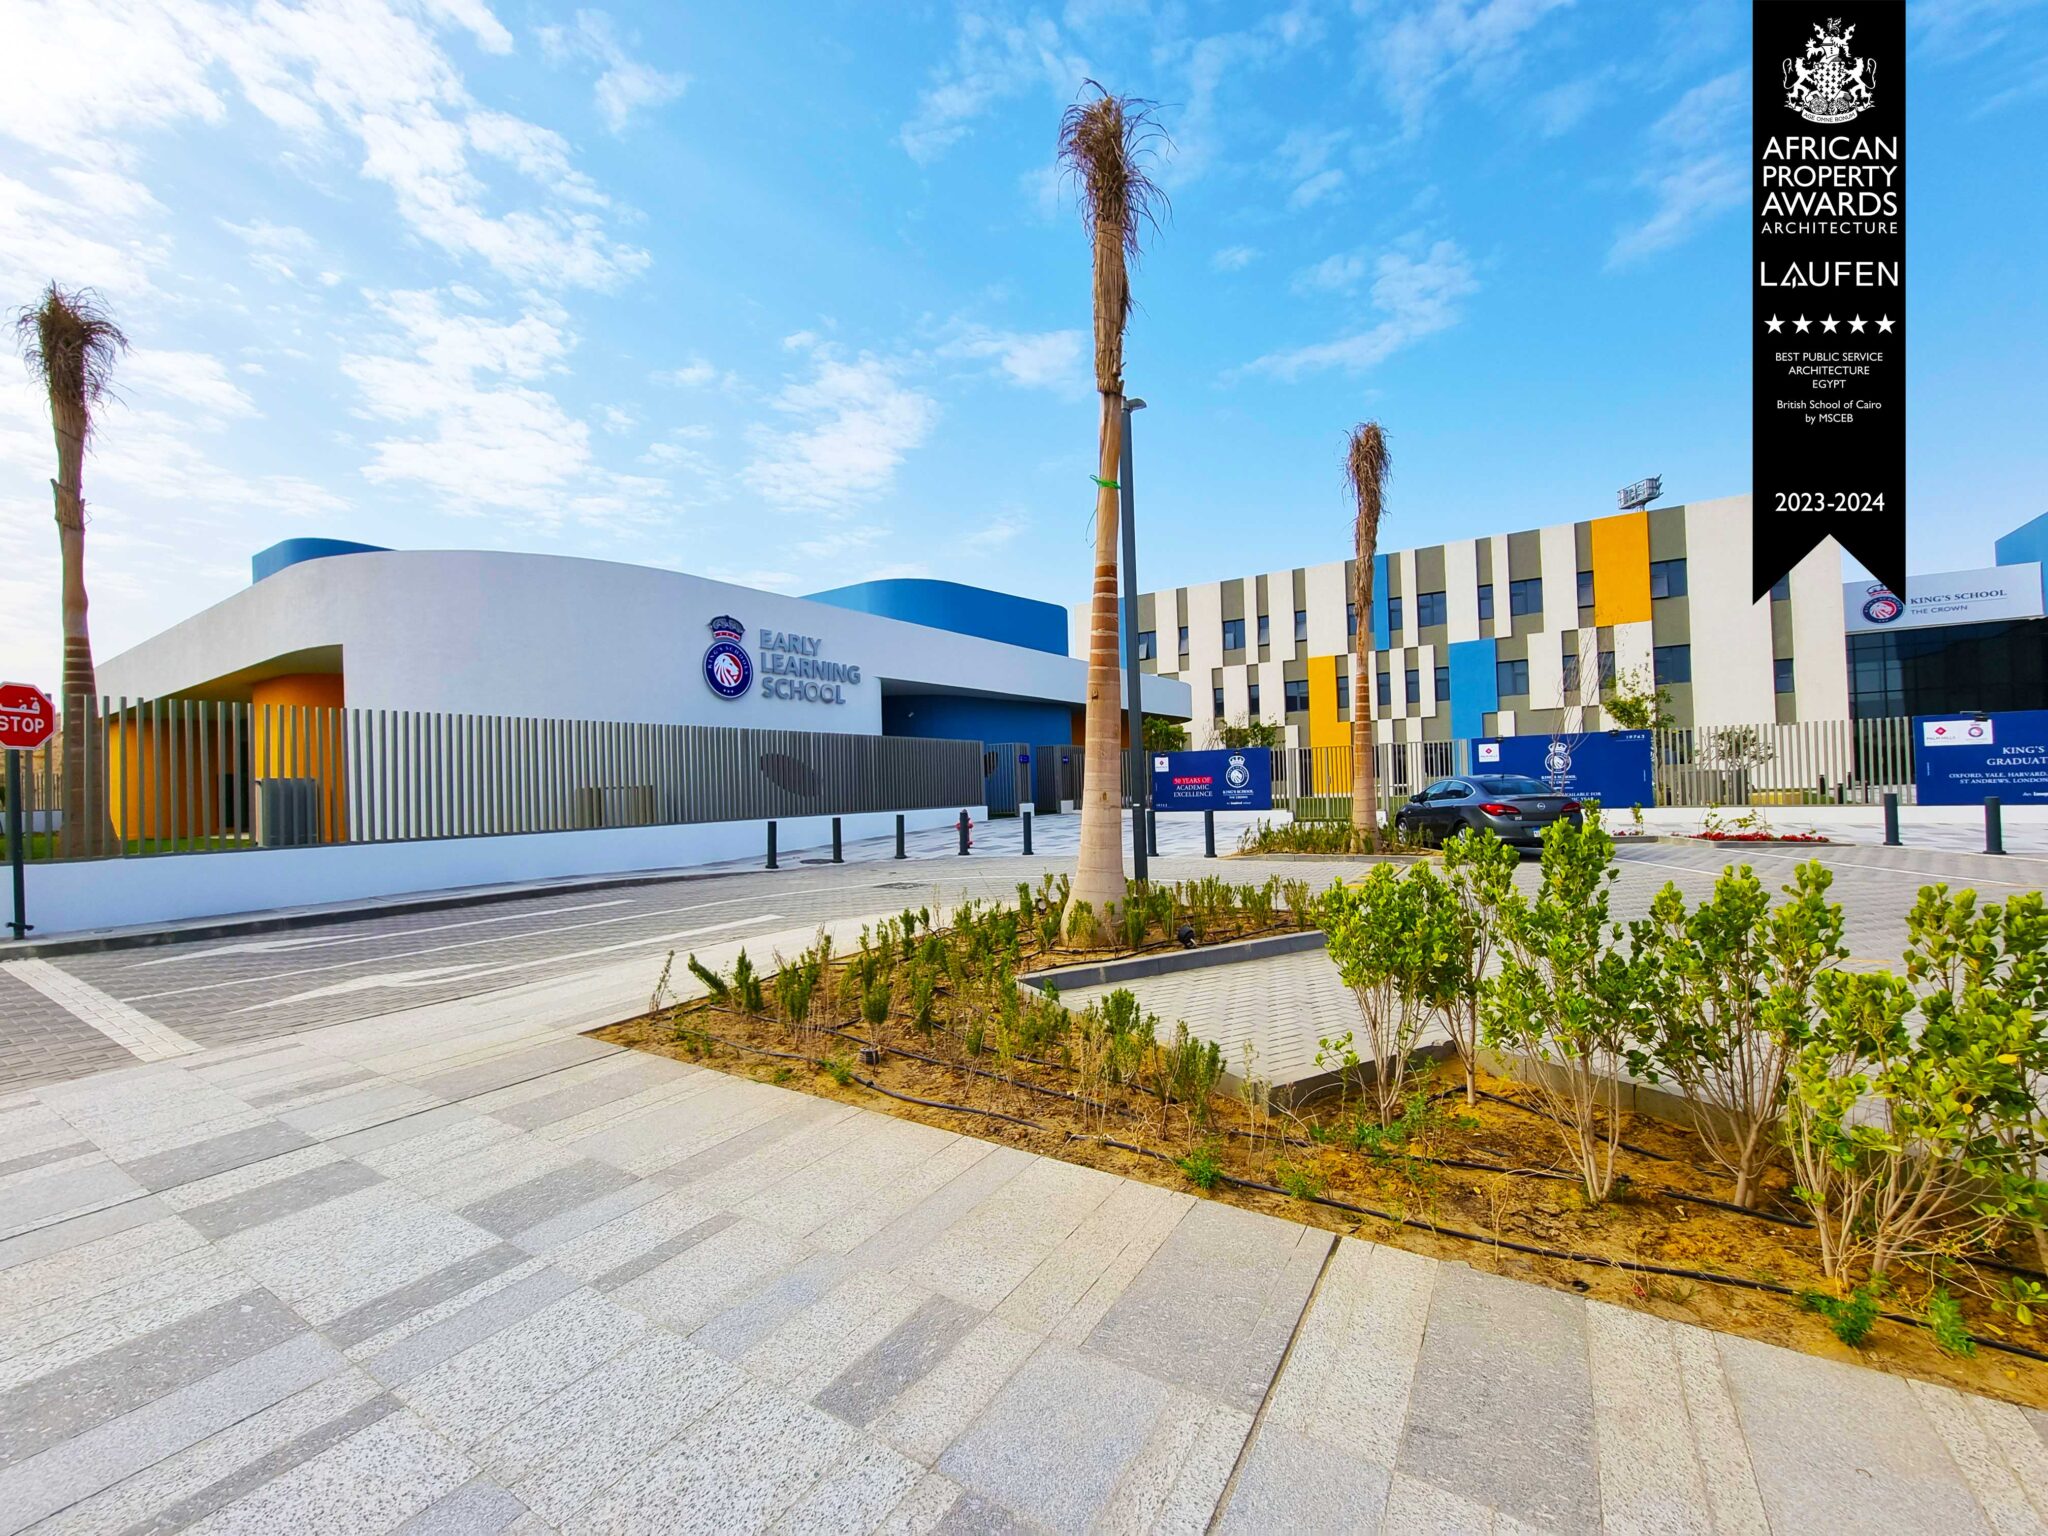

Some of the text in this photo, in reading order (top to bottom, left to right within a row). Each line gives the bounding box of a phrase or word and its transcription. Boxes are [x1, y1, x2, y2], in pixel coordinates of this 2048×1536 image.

[1910, 594, 1951, 605] KING'S
[1954, 589, 2007, 600] SCHOOL
[1930, 605, 1968, 613] CROWN
[759, 628, 822, 657] EARLY
[760, 652, 861, 685] LEARNING
[761, 676, 846, 704] SCHOOL
[0, 715, 45, 733] STOP
[2002, 746, 2045, 754] KING'S
[1173, 790, 1213, 798] EXCELLENCE
